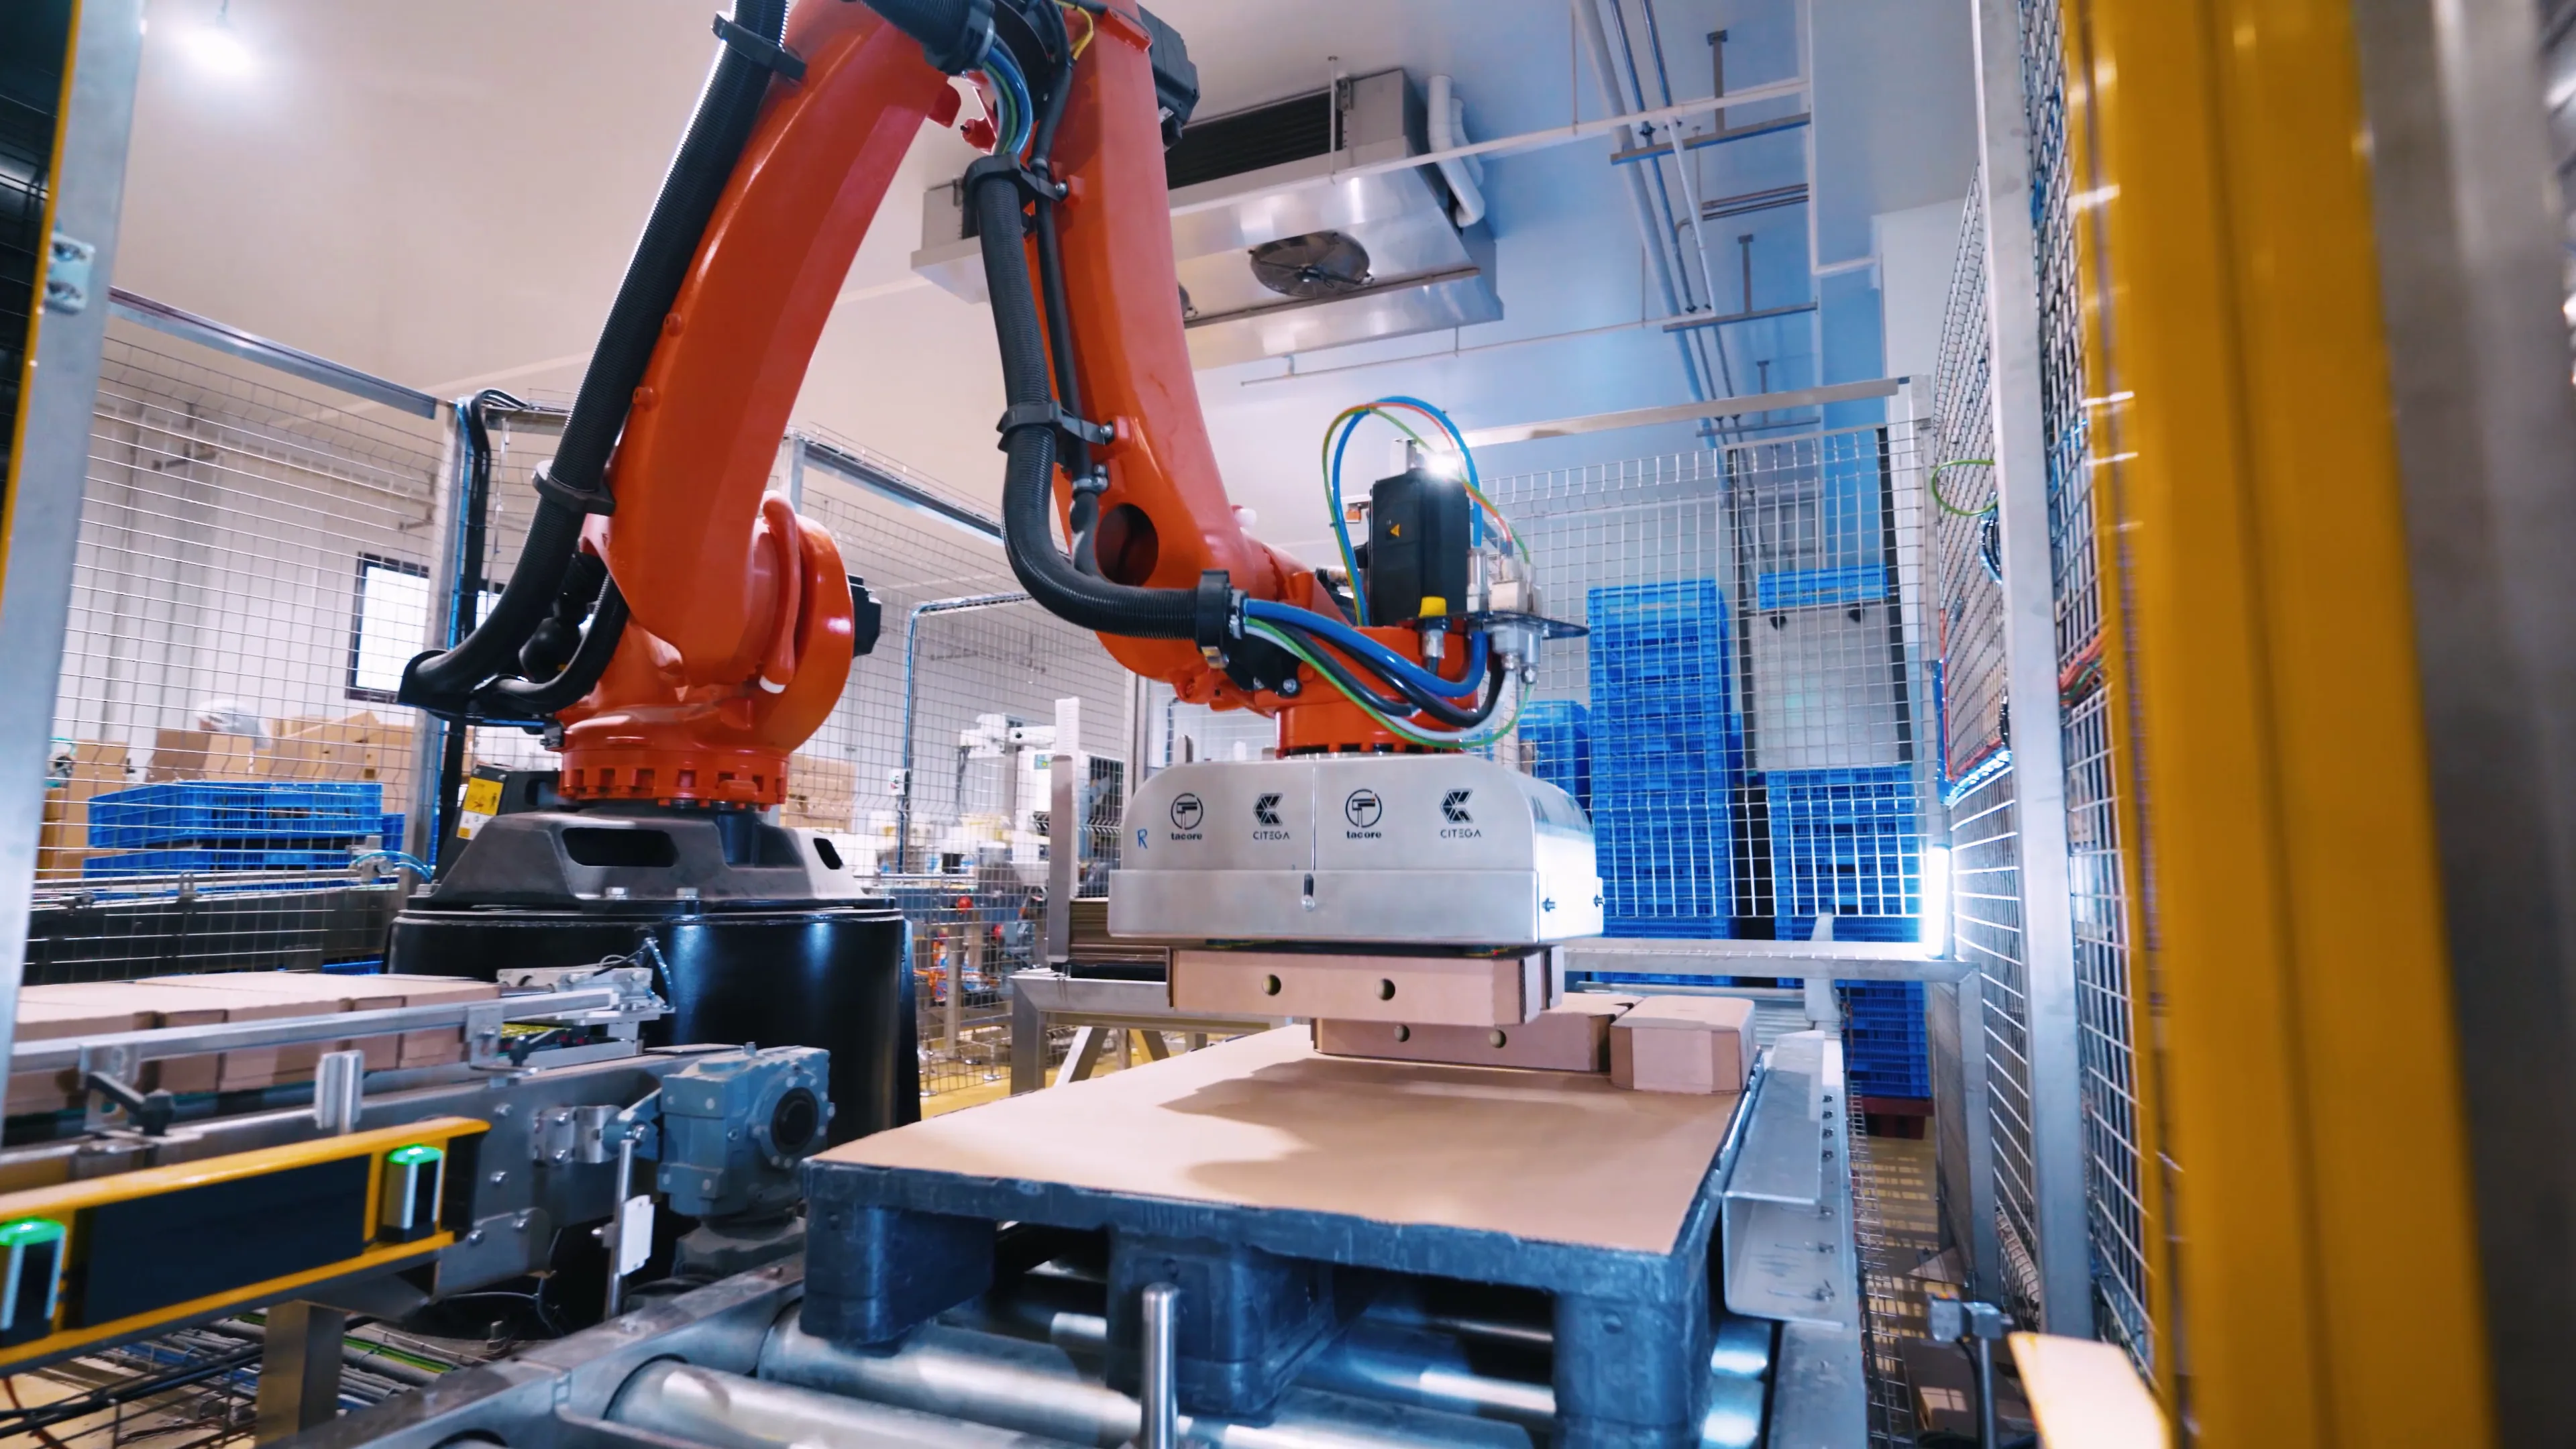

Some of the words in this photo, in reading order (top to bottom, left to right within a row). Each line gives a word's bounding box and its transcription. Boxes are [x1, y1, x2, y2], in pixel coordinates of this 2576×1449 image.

[1137, 828, 1148, 849] R
[1171, 832, 1203, 841] tacore
[1346, 830, 1382, 839] tacore
